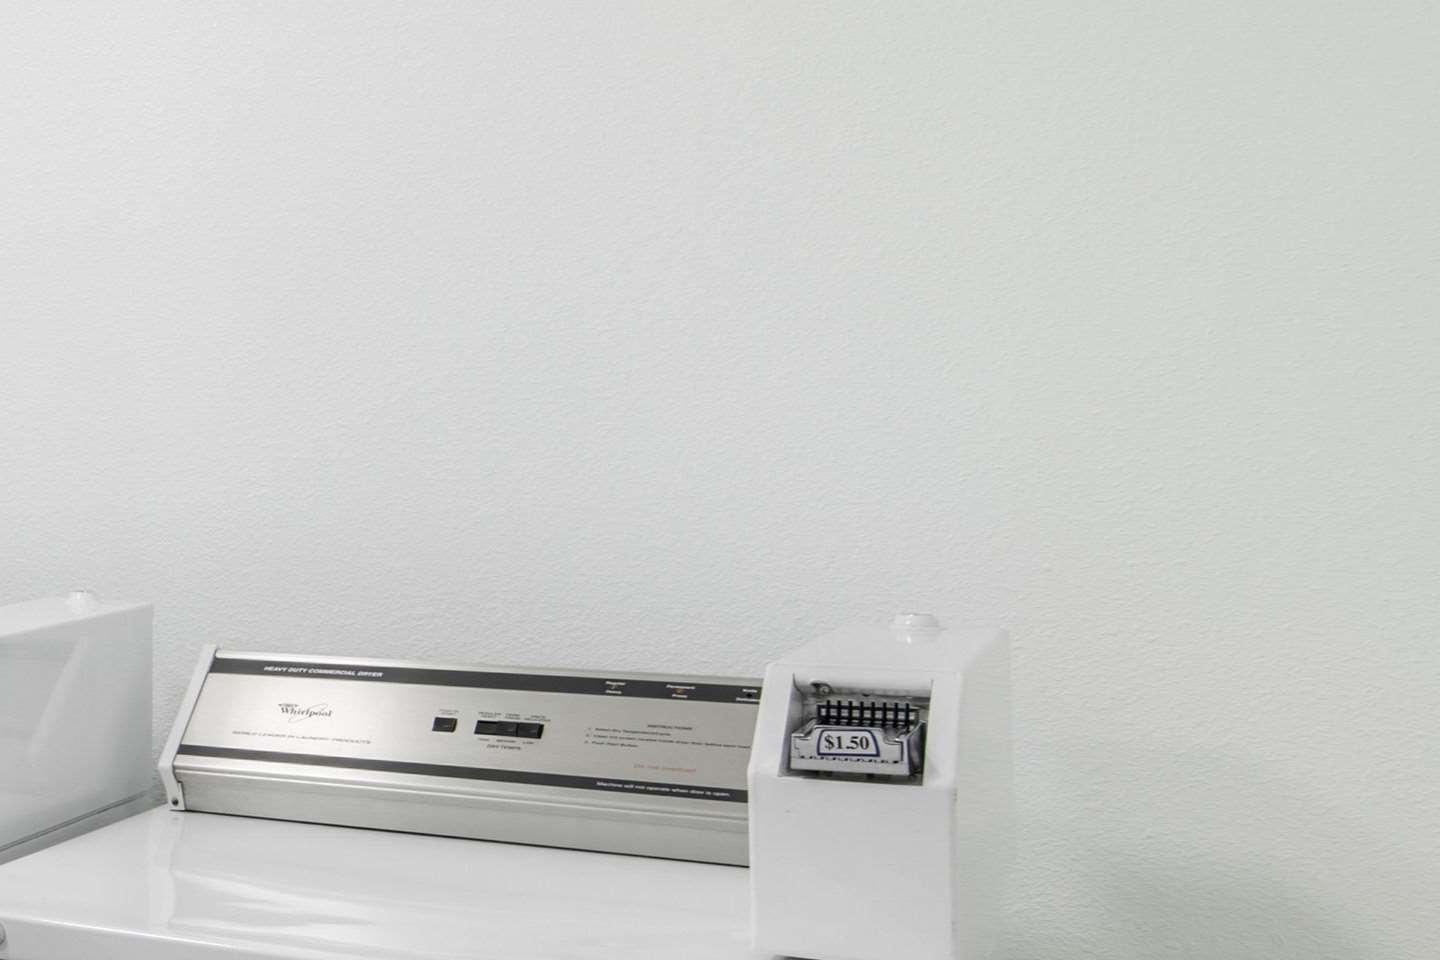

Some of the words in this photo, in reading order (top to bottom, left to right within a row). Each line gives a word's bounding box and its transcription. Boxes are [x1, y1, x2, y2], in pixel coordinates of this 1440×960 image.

[308, 668, 356, 676] COMMERCIAL
[280, 706, 333, 718] Whirlpool
[824, 735, 870, 751] $1.50
